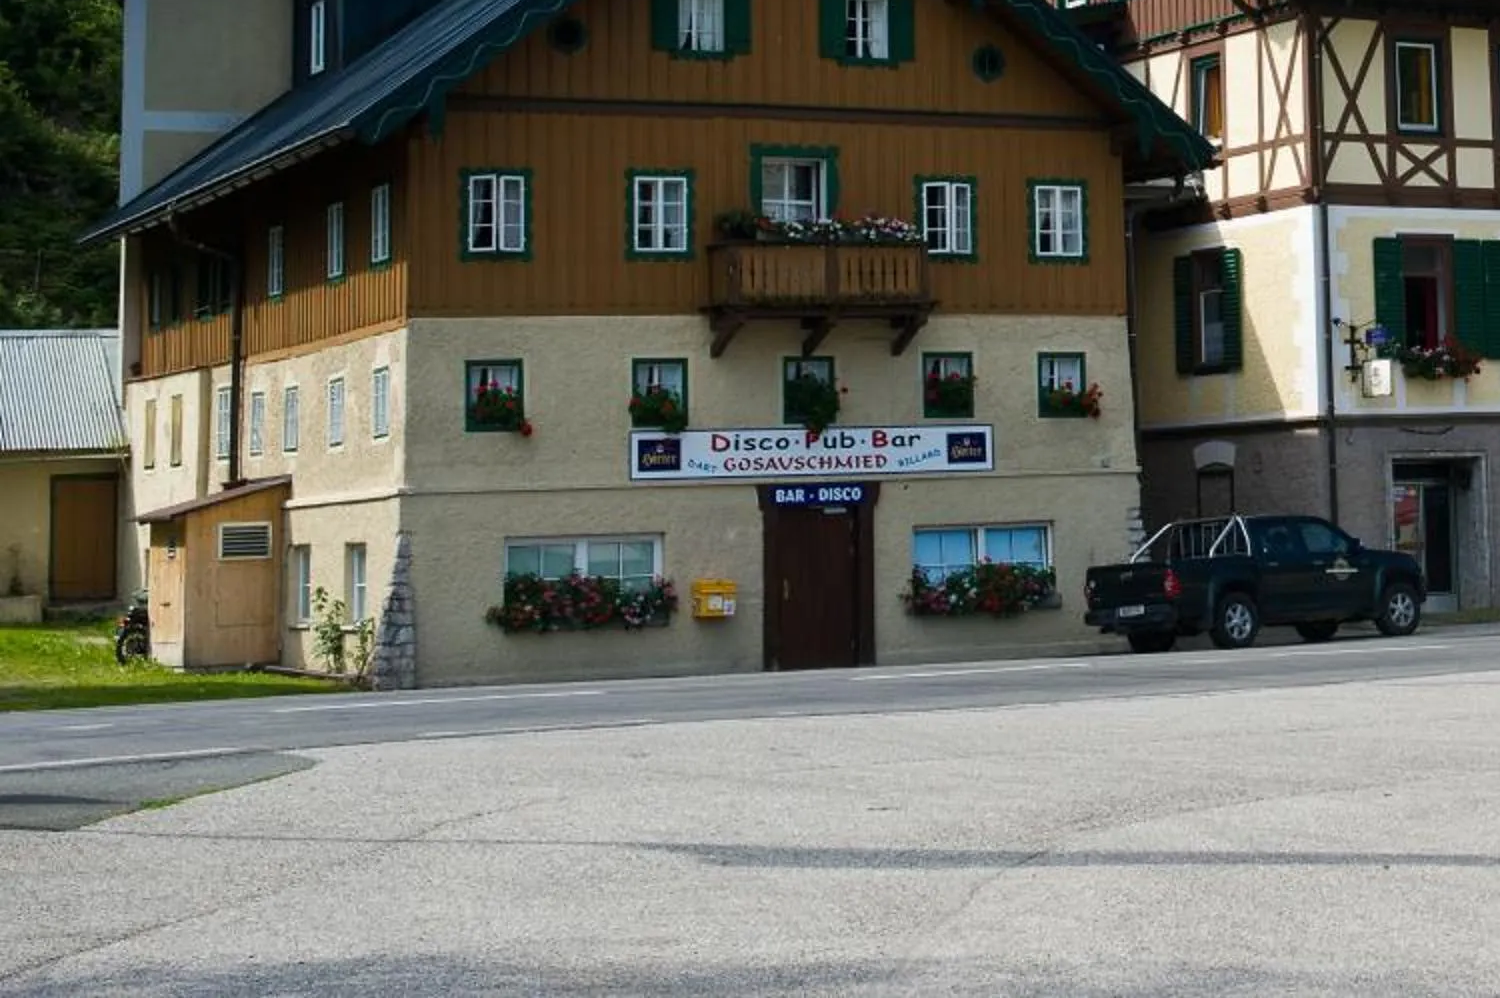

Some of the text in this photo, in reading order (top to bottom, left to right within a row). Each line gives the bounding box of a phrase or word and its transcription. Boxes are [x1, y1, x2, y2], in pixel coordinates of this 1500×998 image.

[711, 430, 921, 452] Disco Pub Bar
[775, 487, 862, 503] BAR DISCO
